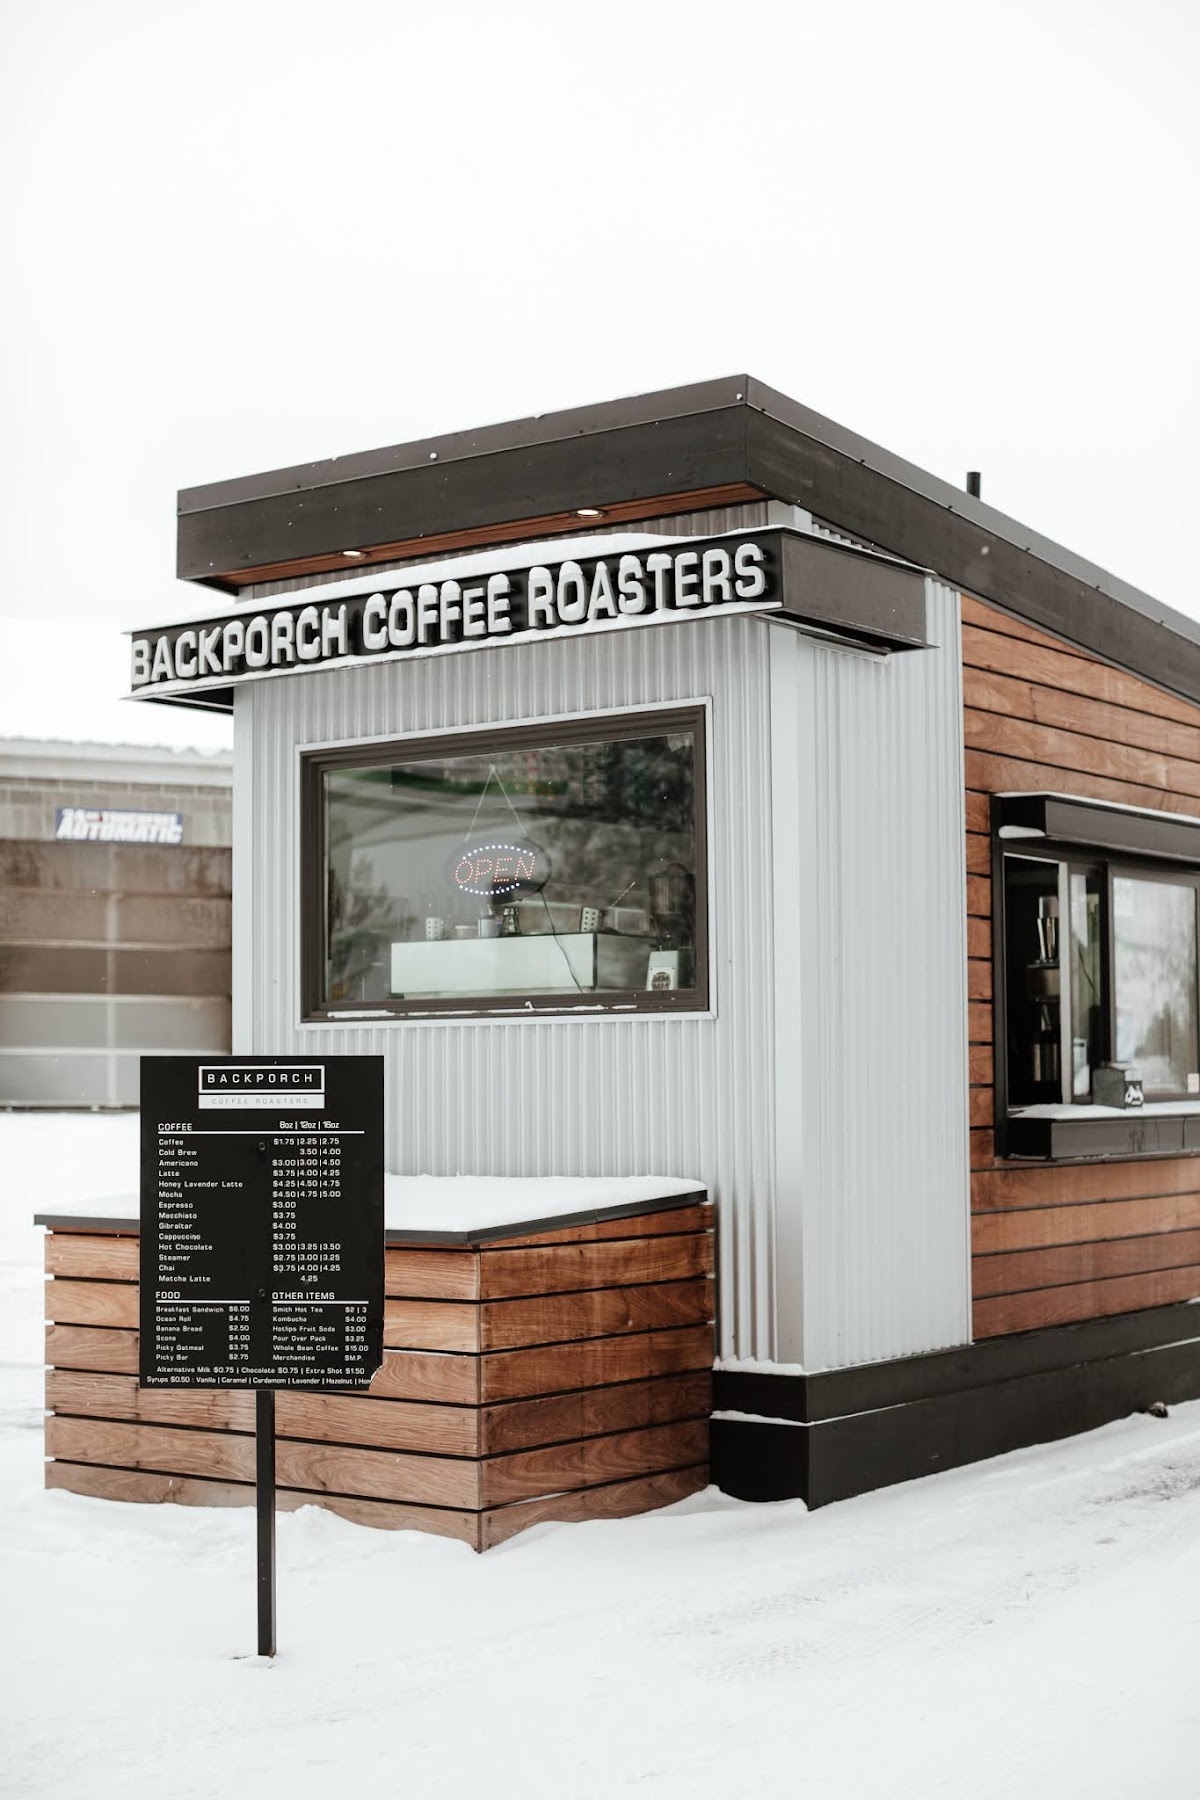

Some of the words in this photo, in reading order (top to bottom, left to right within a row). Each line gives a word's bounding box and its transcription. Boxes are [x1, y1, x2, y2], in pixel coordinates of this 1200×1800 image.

[132, 604, 349, 685] BACKPORCH
[363, 573, 512, 650] COFFEE
[528, 543, 766, 627] ROASTERS
[56, 820, 184, 844] AUTOMATIC
[455, 855, 536, 884] OPEN
[207, 1073, 313, 1084] BACKPORCH
[157, 1122, 193, 1131] COFFEE
[279, 1120, 294, 1130] 8oz
[299, 1120, 317, 1129] 12oz
[322, 1120, 340, 1129] 16oz
[158, 1138, 184, 1146] Coffee
[273, 1137, 295, 1146] $1.75
[158, 1148, 175, 1157] Cold
[177, 1148, 198, 1156] Brew
[300, 1147, 318, 1156] 3.50
[158, 1159, 199, 1167] Americano
[271, 1158, 297, 1167] $3.00
[158, 1169, 180, 1177] Latte
[272, 1169, 296, 1177] $3.75
[158, 1180, 182, 1189] Honey
[183, 1180, 219, 1188] Lavender
[221, 1180, 243, 1188] Latte
[272, 1179, 296, 1188] $4.25
[158, 1190, 183, 1198] Mocha
[272, 1190, 297, 1198] $4.50
[158, 1201, 194, 1210] Espresso
[272, 1200, 297, 1209] $3.00
[158, 1211, 198, 1219] Macchiato
[272, 1211, 296, 1220] $3.75
[158, 1221, 193, 1230] Gibraltar
[272, 1221, 297, 1230] $4.00
[158, 1232, 201, 1242] Cappuccino
[272, 1232, 296, 1241] $3.75
[158, 1243, 173, 1251] Hot
[175, 1243, 213, 1251] Chocolate
[272, 1243, 297, 1251] $3.00
[158, 1253, 191, 1262] Steamer
[272, 1253, 297, 1262] $2.75
[158, 1263, 175, 1272] Chai
[272, 1264, 297, 1272] $3.75
[158, 1274, 187, 1283] Matcha
[189, 1275, 211, 1283] Latte
[300, 1274, 319, 1283] 4.25
[155, 1291, 181, 1300] FOOD
[271, 1291, 304, 1300] OTHER
[305, 1291, 335, 1300] ITEMS
[178, 1315, 192, 1323] Roll
[228, 1314, 250, 1322] $4.75
[272, 1315, 308, 1323] Kombucha
[344, 1315, 367, 1323] $4.00
[155, 1324, 181, 1332] Banana
[228, 1324, 250, 1332] $2.50
[272, 1325, 297, 1333] Hotlips
[298, 1325, 317, 1333] Fruit
[318, 1325, 336, 1333] Soda
[344, 1325, 367, 1333] $3.00
[155, 1334, 177, 1342] Scone
[228, 1334, 251, 1342] $4.00
[272, 1334, 289, 1342] Pour
[155, 1343, 174, 1352] Picky
[228, 1343, 249, 1351] $3.75
[315, 1344, 339, 1352] Coffee
[344, 1344, 369, 1352] $15.00
[155, 1353, 174, 1362] Picky
[175, 1353, 189, 1361] Bar
[228, 1353, 249, 1361] $2.75
[156, 1365, 196, 1373] Alternative
[213, 1366, 235, 1374] $0.75
[240, 1366, 276, 1374] Chocolate
[277, 1366, 299, 1374] $0.75
[305, 1366, 326, 1375] Extra
[326, 1367, 343, 1375] Shot
[344, 1367, 365, 1375] $1.50
[146, 1375, 169, 1384] Syrups
[169, 1375, 191, 1384] $0.50
[195, 1376, 217, 1384] Vanilla
[220, 1376, 248, 1384] Caramel
[252, 1376, 287, 1384] Cardamom
[291, 1377, 321, 1385] Lavender
[325, 1377, 353, 1385] Hazelnut
